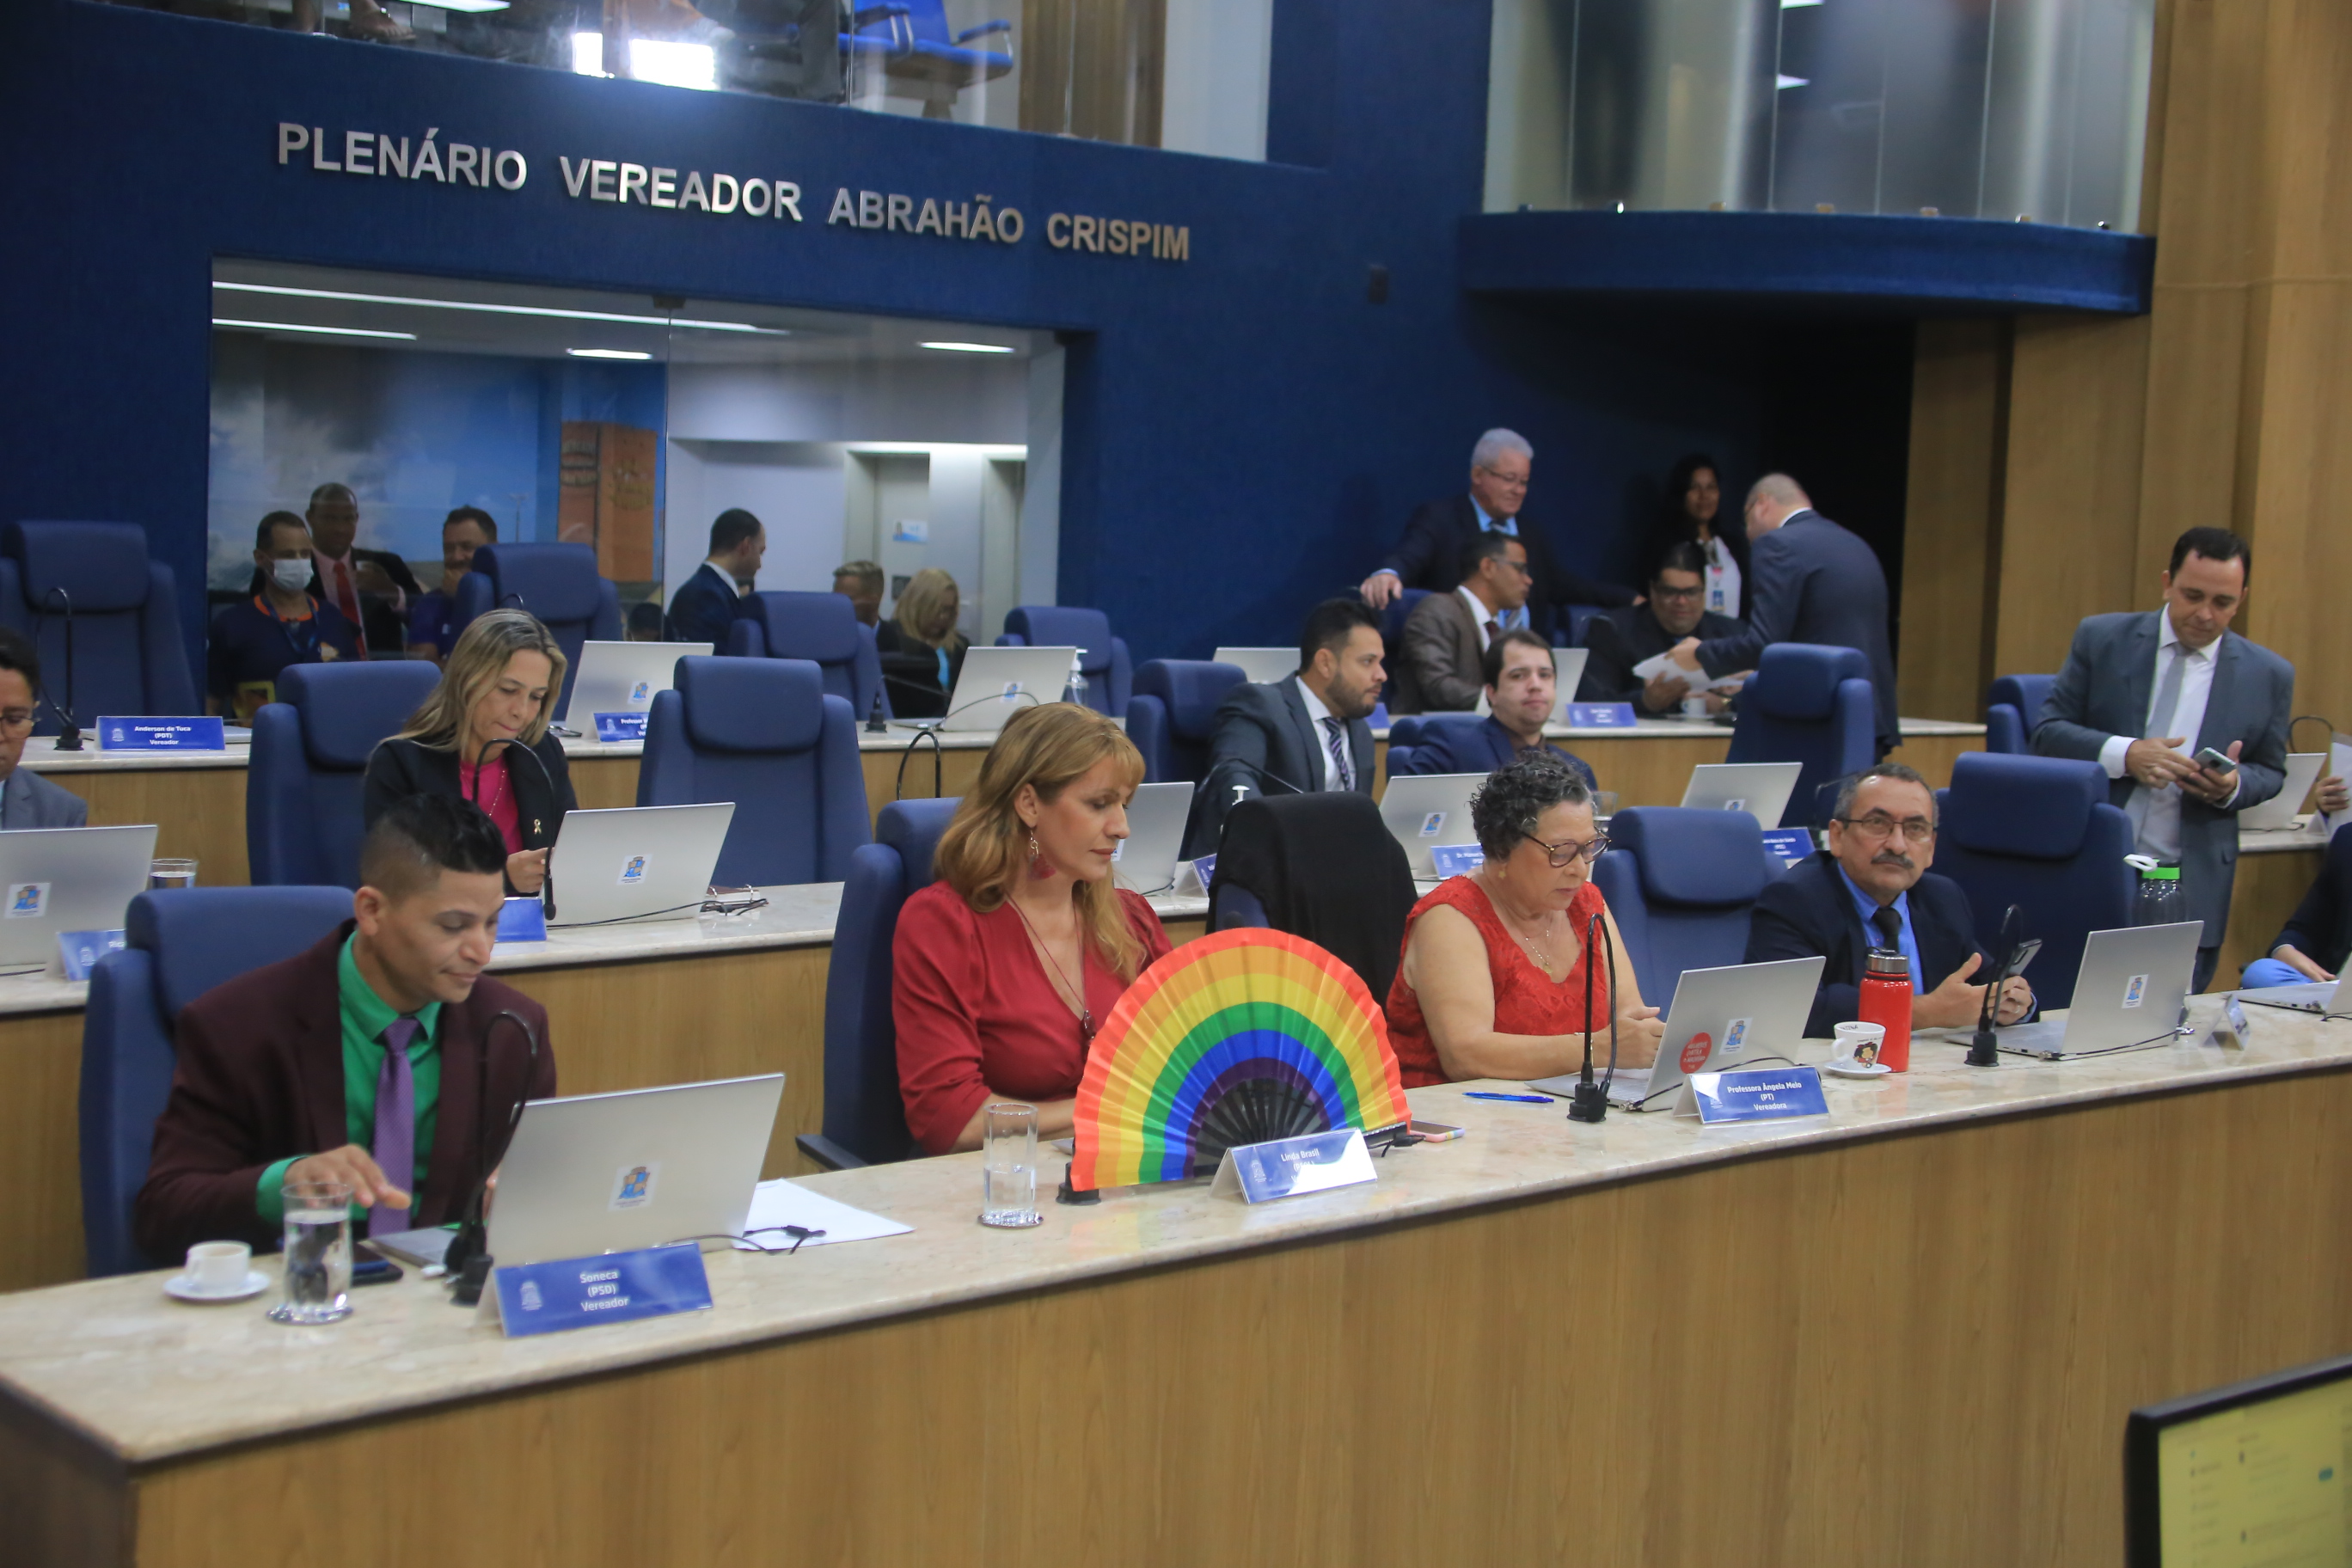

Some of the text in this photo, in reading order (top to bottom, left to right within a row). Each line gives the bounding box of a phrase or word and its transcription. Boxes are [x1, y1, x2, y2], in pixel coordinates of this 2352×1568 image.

[279, 122, 1190, 261] PLENÁRIO VEREADOR ABRAHÃO CRISPIM
[1726, 1081, 1802, 1093] Professora Ângela Melo
[1753, 1103, 1787, 1112] Vereadora
[1280, 1148, 1320, 1162] Linda Brasil
[579, 1270, 619, 1284] Soneca
[587, 1283, 616, 1298] (PSD)
[580, 1296, 630, 1313] Vereador
